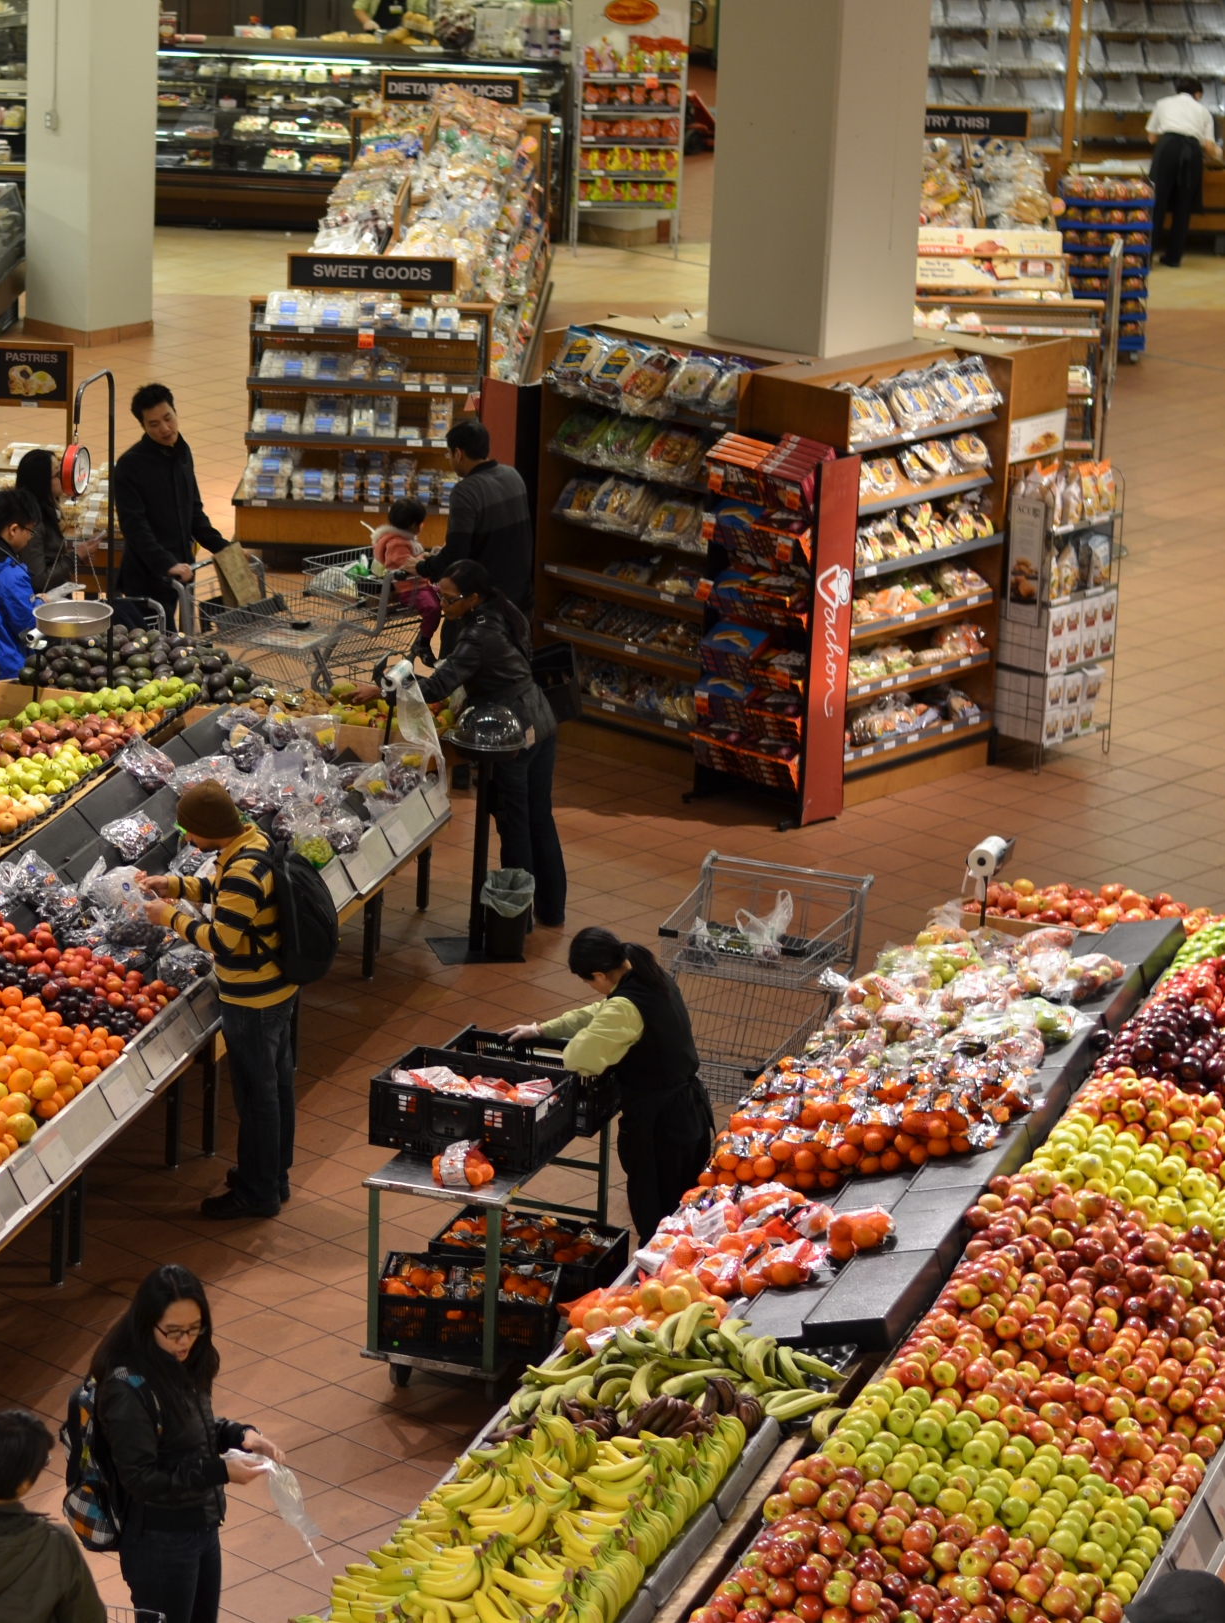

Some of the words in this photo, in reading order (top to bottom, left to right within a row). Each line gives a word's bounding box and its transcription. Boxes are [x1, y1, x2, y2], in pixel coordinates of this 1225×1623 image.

[460, 84, 514, 98] HOICES
[953, 115, 991, 130] THIS!
[312, 263, 368, 279] SWEET
[372, 265, 432, 281] GOODS
[5, 351, 58, 364] PASTRIES
